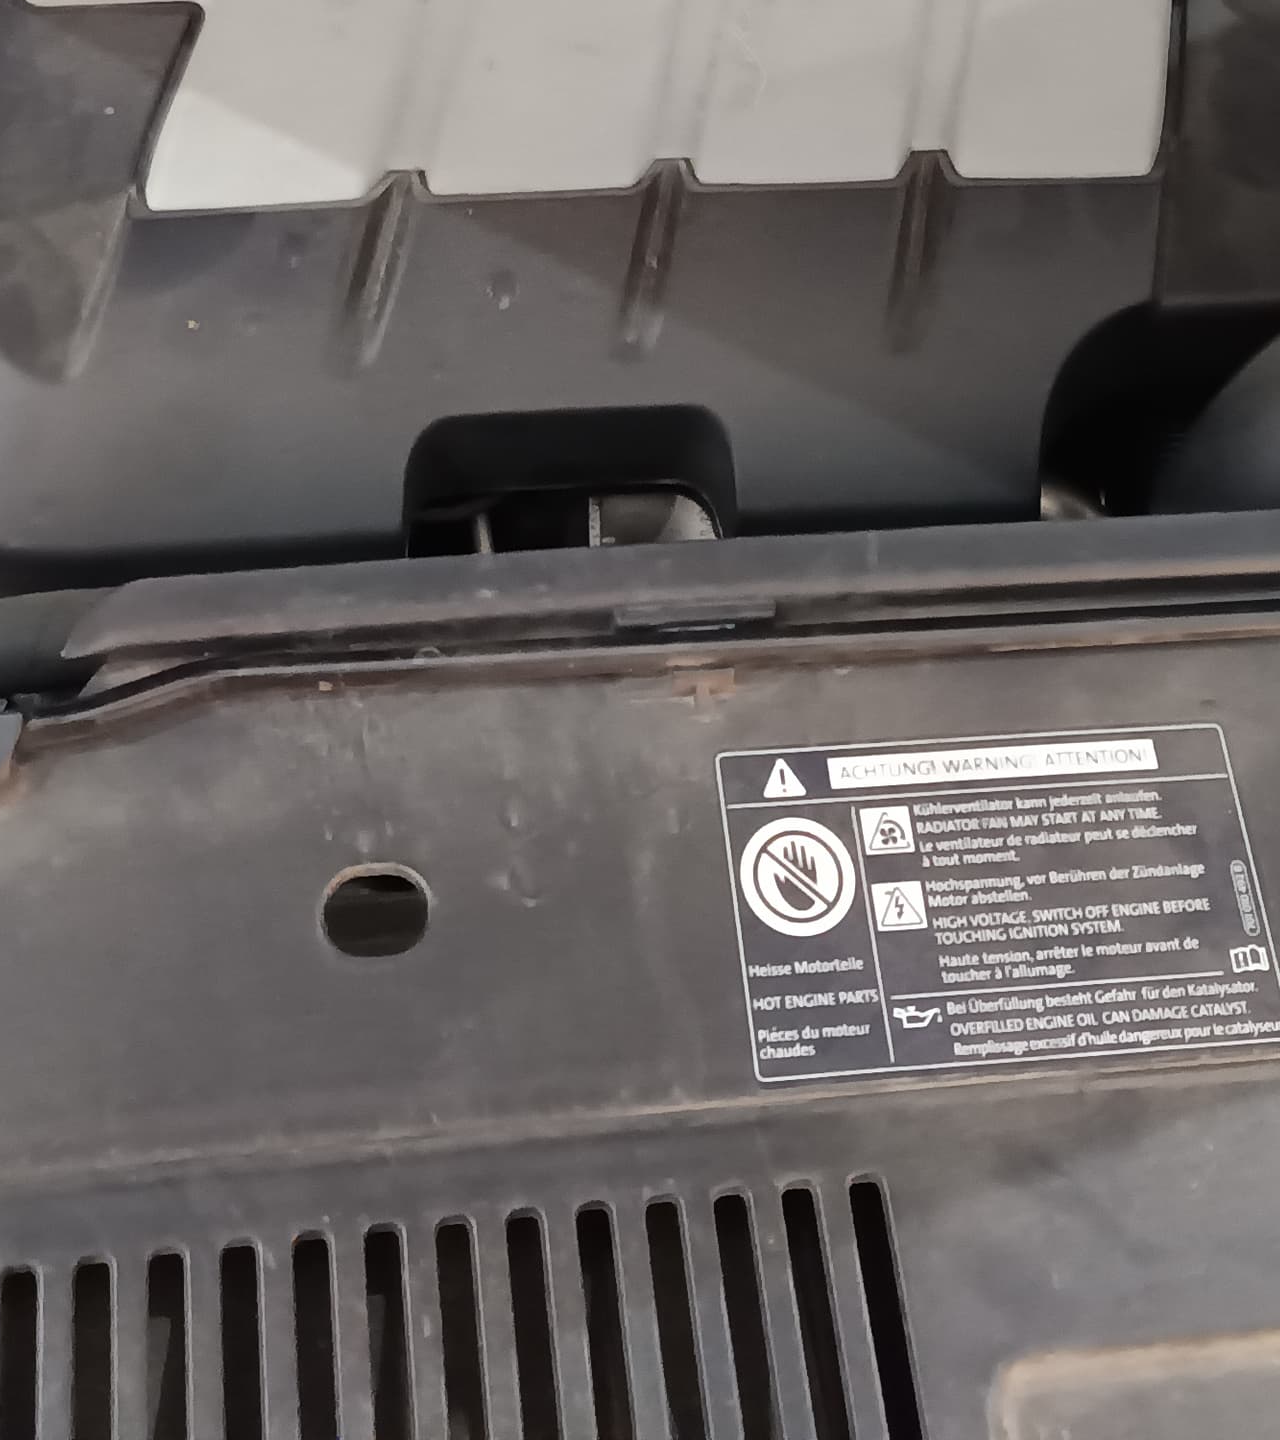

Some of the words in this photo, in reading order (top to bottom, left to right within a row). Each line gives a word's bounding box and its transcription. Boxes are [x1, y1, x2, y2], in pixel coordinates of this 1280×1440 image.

[840, 760, 936, 780] ACHTUNG!
[1015, 797, 1047, 809] kann
[916, 818, 980, 834] RADIATOR
[981, 817, 1008, 830] FAN
[1009, 814, 1039, 828] MAY
[1041, 811, 1078, 826] START
[1081, 810, 1097, 823] AT
[1100, 808, 1126, 821] ANY
[1127, 807, 1162, 820] TIME.
[920, 840, 934, 853] Le
[936, 836, 1004, 851] ventilateur
[1007, 834, 1023, 846] de
[1024, 831, 1081, 845] radiateur
[1084, 828, 1113, 845] peut
[1115, 829, 1130, 839] se
[932, 853, 960, 867] tout
[963, 849, 1020, 864] moment.
[1026, 874, 1047, 885] vor
[1048, 869, 1107, 884] Berühren
[1109, 866, 1130, 880] der
[1132, 863, 1205, 879] Zündanlage
[928, 894, 968, 907] Motor
[971, 890, 1032, 905] abstellen.
[932, 915, 968, 929] HIGH
[1032, 907, 1083, 923] SWITCH
[1085, 904, 1109, 919] OFF
[1111, 901, 1161, 917] ENGINE
[1163, 898, 1210, 914] BEFORE
[934, 928, 1007, 945] TOUCHING
[1009, 923, 1069, 940] IGNITION
[1071, 919, 1125, 936] SYSTEM.
[938, 954, 980, 968] Haute
[982, 950, 1034, 964] tension,
[1036, 946, 1079, 960] arrêter
[1081, 944, 1094, 957] le
[1096, 942, 1142, 956] moteur
[1145, 937, 1181, 953] avant
[1183, 936, 1199, 950] de
[748, 963, 792, 977] Heisse
[794, 957, 864, 974] Motorteile
[941, 969, 992, 984] toucher
[753, 996, 782, 1010] HOT
[784, 992, 836, 1009] ENGINE
[838, 989, 879, 1004] PARTS
[946, 1001, 967, 1015] Bei
[968, 996, 1045, 1013] Überfüllung
[1045, 992, 1093, 1008] besteht
[1094, 988, 1137, 1004] Gefahr
[1141, 986, 1160, 1000] für
[1162, 984, 1186, 999] den
[1187, 980, 1259, 998] Katalysator.
[950, 1018, 1024, 1037] OVERFILLED
[1025, 1014, 1074, 1031] ENGINE
[1076, 1012, 1098, 1027] OIL
[1102, 1010, 1131, 1025] CAN
[1131, 1006, 1189, 1022] DAMAGE
[1190, 1000, 1251, 1017] CATALYST.
[801, 1025, 820, 1039] du
[822, 1024, 870, 1038] moteur
[1078, 1031, 1117, 1046] d'huile
[1119, 1028, 1183, 1045] dangereux
[1184, 1024, 1212, 1043] pour
[1213, 1023, 1224, 1036] le
[760, 1043, 816, 1060] chaudes
